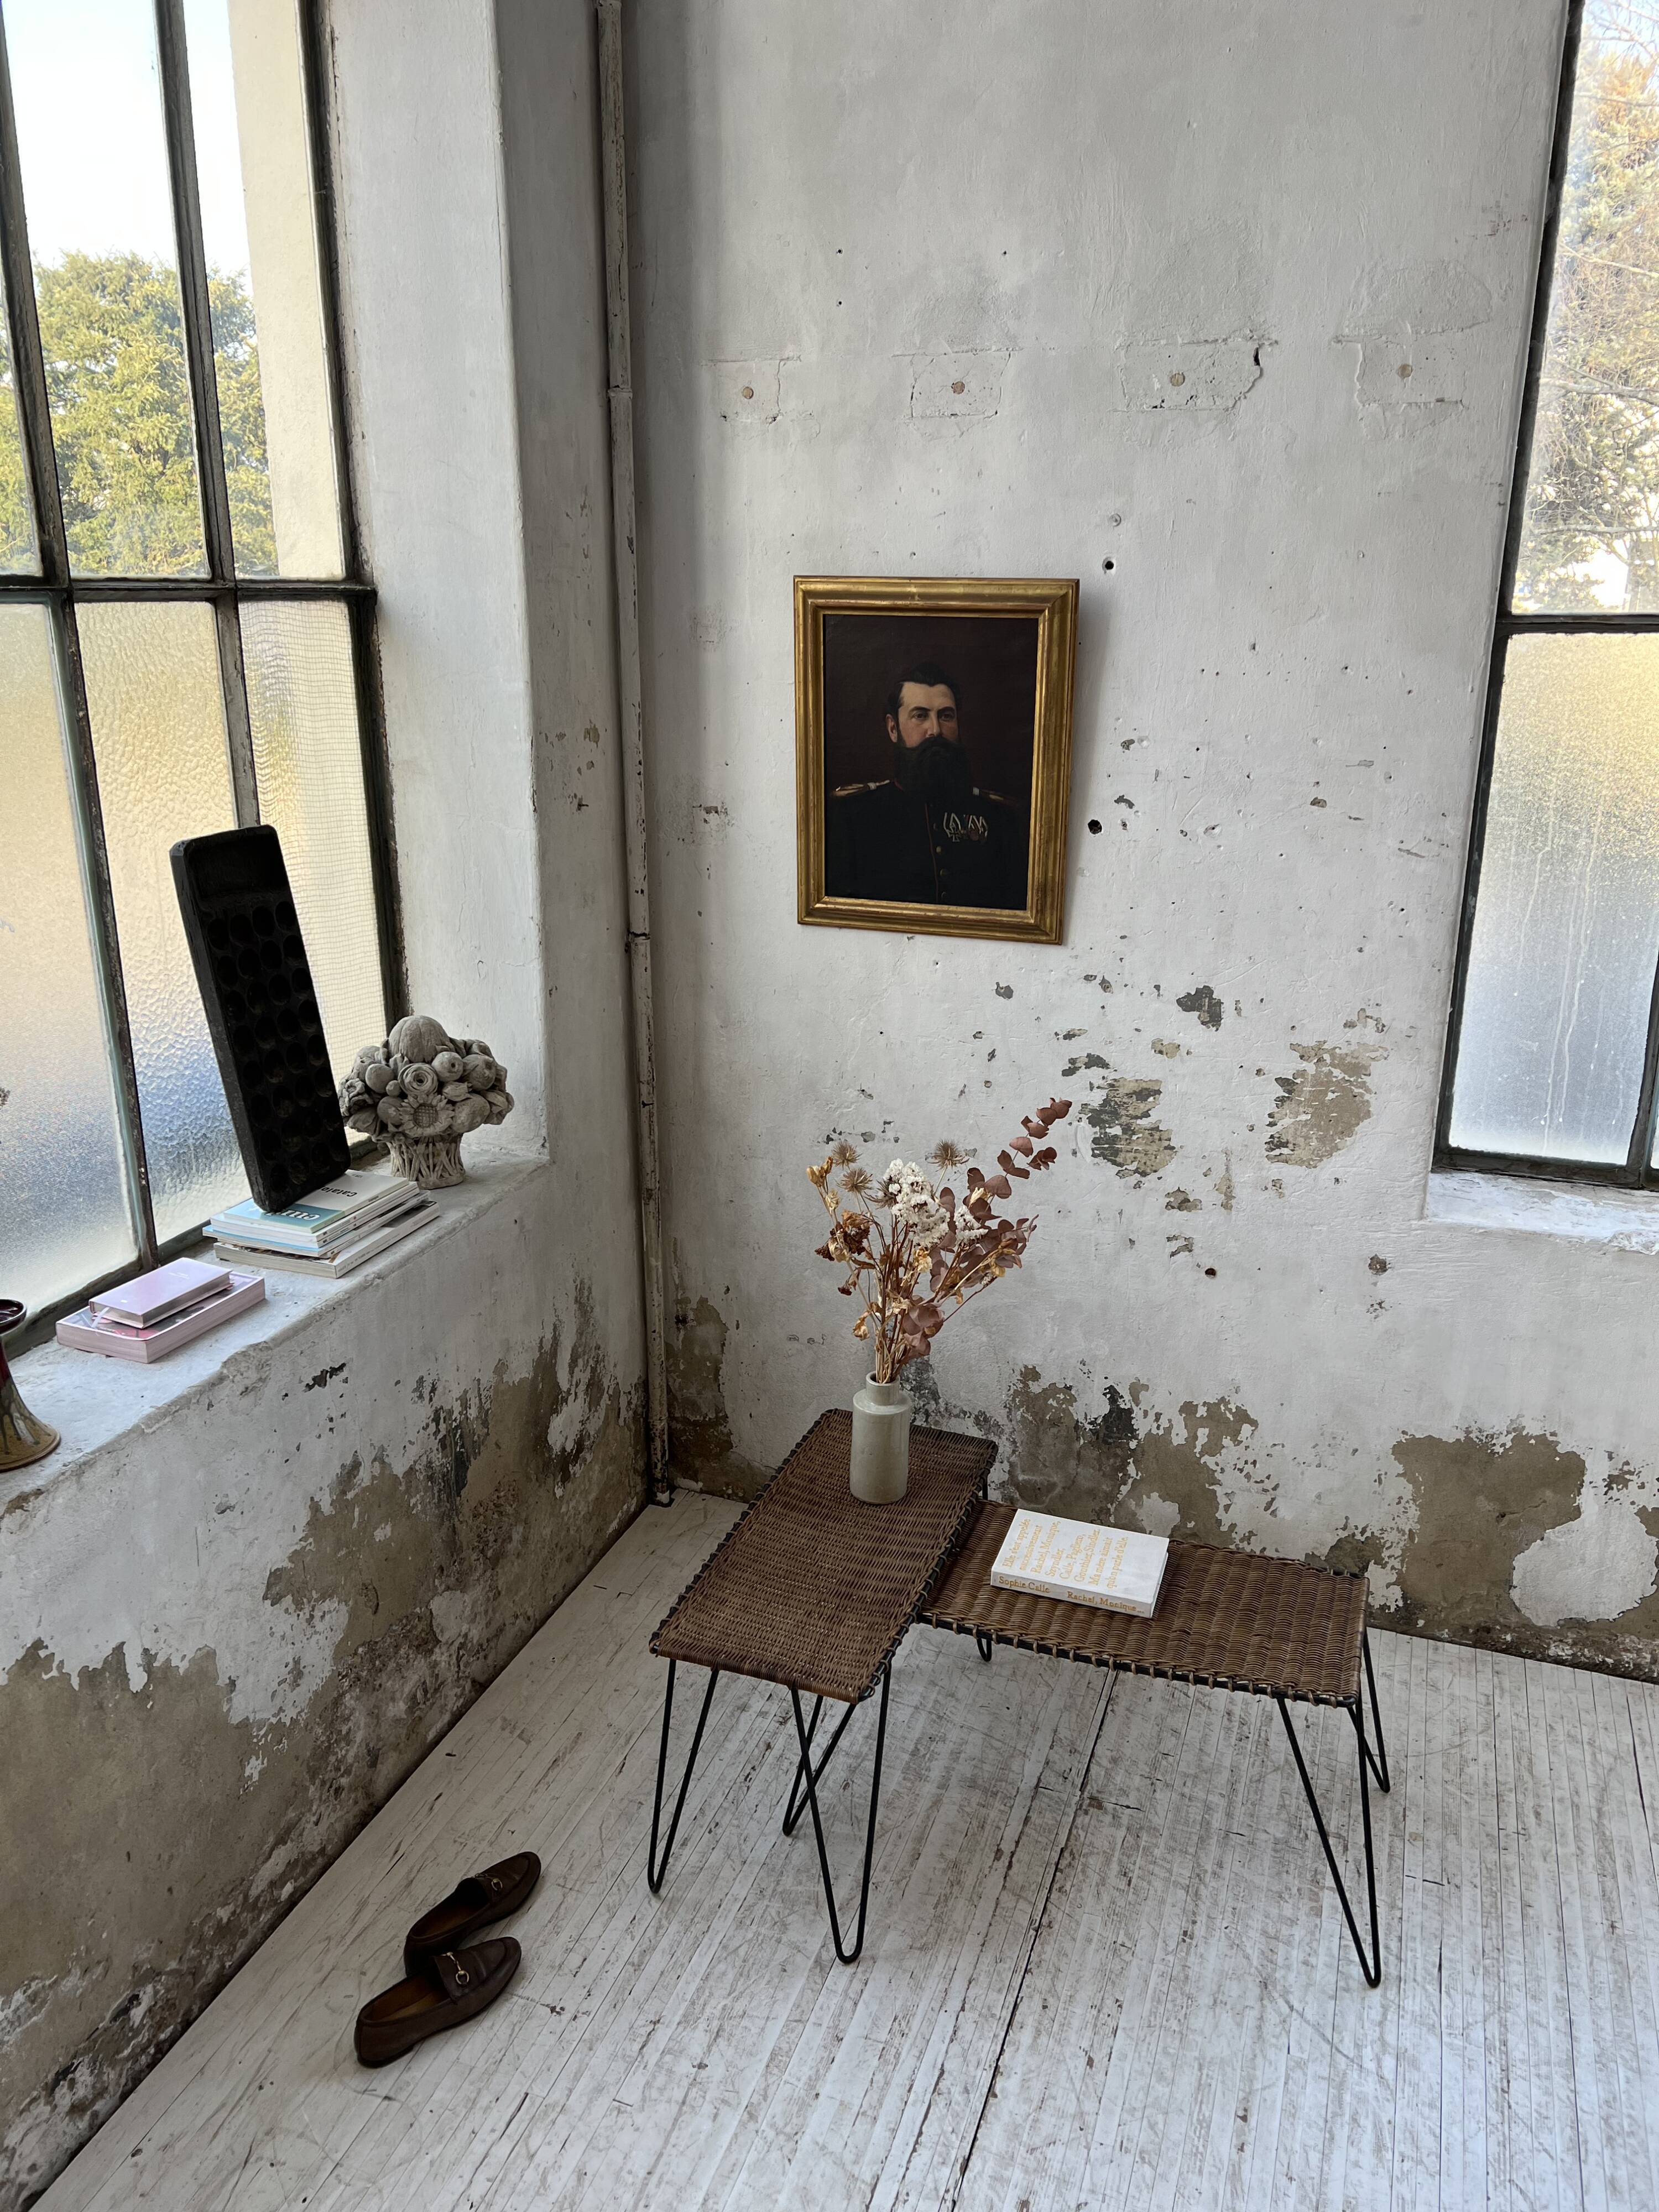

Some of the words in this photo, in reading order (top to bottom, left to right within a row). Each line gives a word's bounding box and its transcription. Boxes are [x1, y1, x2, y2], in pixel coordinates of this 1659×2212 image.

[321, 1187, 358, 1197] Catalo
[1002, 1555, 1016, 1567] Elle
[1019, 1525, 1042, 1571] successivement
[1030, 1551, 1050, 1573] Rachel,
[1040, 1521, 1061, 1550] Monique,
[1088, 1574, 1101, 1586] Ma
[1099, 1537, 1113, 1557] aimait
[1045, 1548, 1066, 1577] Szyndler,
[1059, 1561, 1077, 1579] Calle,
[1074, 1553, 1095, 1582] Gonthier,
[1105, 1571, 1118, 1589] qu'on
[1112, 1554, 1123, 1572] parle
[999, 1575, 1027, 1589] Sophie
[1028, 1582, 1050, 1593] Calle
[1066, 1591, 1098, 1605] Rachel,
